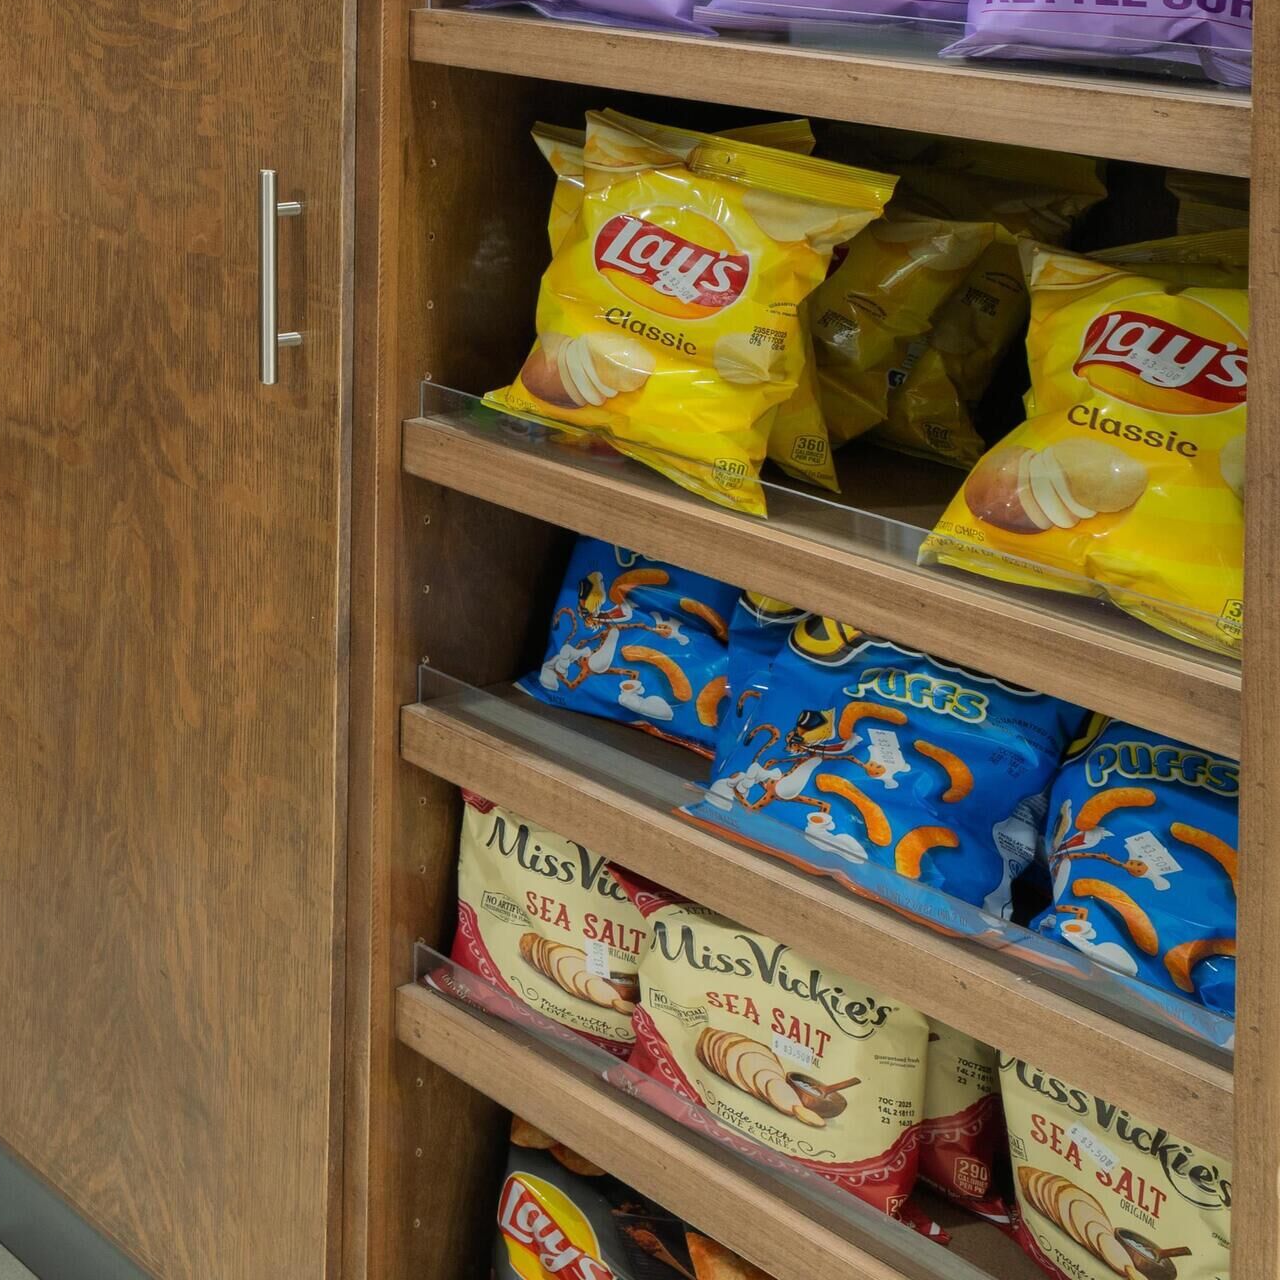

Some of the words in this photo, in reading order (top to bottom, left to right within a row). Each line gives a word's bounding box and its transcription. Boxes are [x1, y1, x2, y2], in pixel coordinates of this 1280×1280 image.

[600, 221, 742, 296] Lay's
[604, 307, 697, 356] Classic
[1081, 314, 1247, 388] Lay's
[797, 438, 824, 453] 360
[1067, 404, 1199, 459] Classic
[486, 817, 575, 883] Miss
[526, 891, 571, 931] SEA
[583, 913, 646, 955] SALT
[651, 921, 753, 977] Miss
[734, 934, 892, 1040] Vickie's
[705, 991, 760, 1025] SEA
[771, 1007, 831, 1058] SALT
[717, 1107, 745, 1129] LOVE
[1030, 1114, 1082, 1170] SEA
[1120, 1199, 1156, 1230] ORIGINAL
